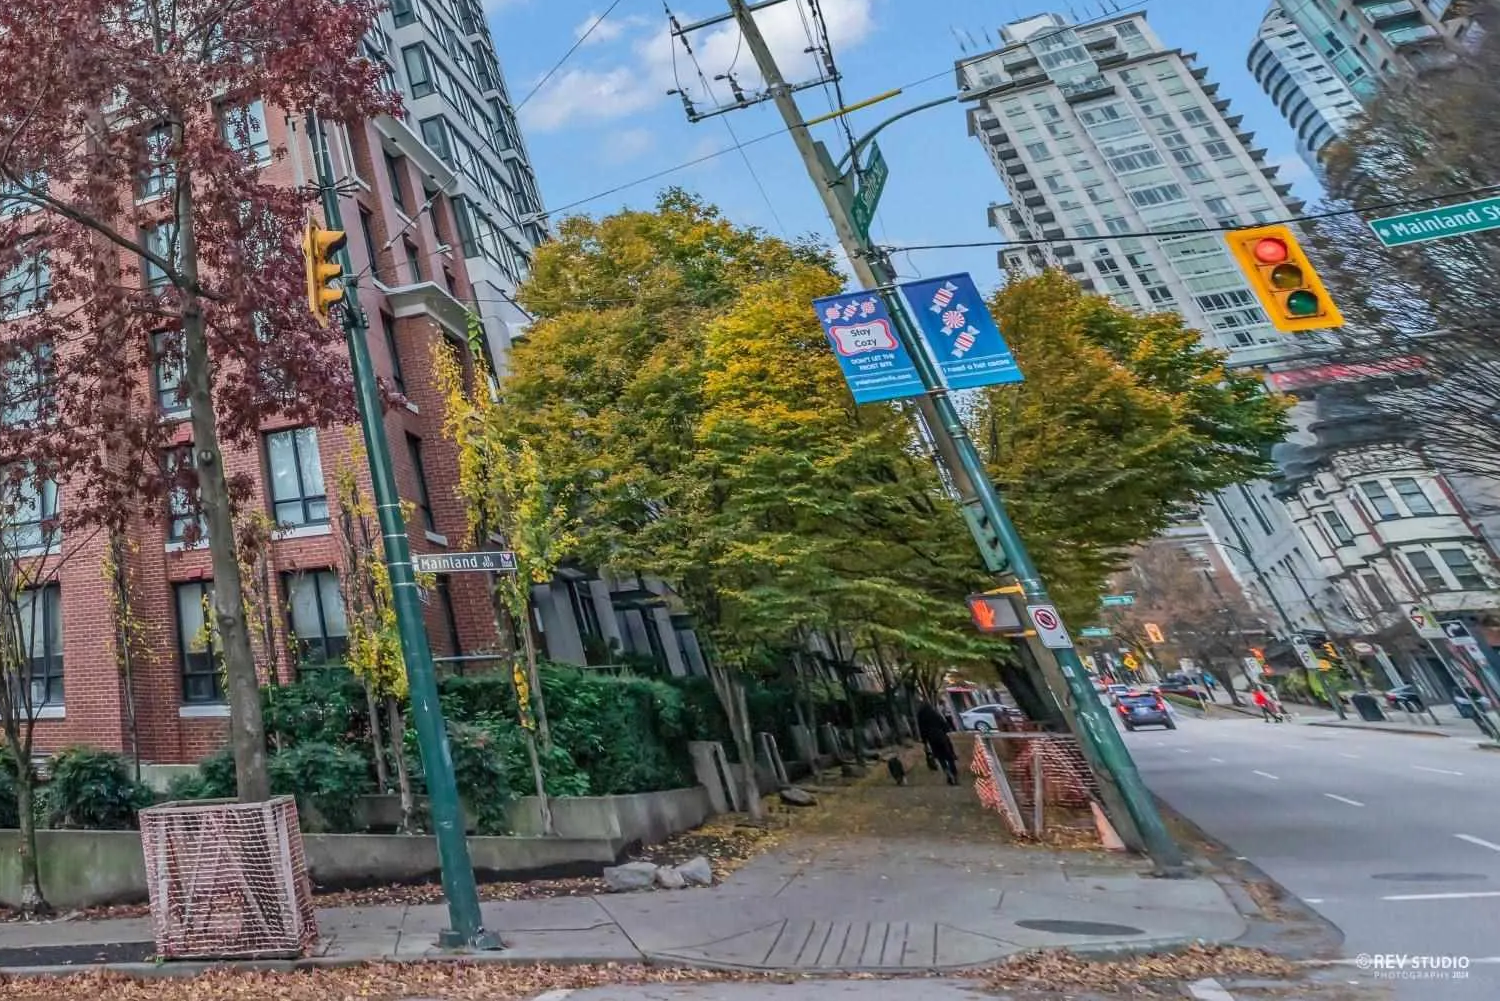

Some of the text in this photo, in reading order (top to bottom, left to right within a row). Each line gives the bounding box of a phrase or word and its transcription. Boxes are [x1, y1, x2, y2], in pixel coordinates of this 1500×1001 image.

[1391, 209, 1482, 236] Mainland
[850, 329, 871, 337] Stay
[854, 339, 877, 347] Cozy
[421, 556, 478, 570] Mainland
